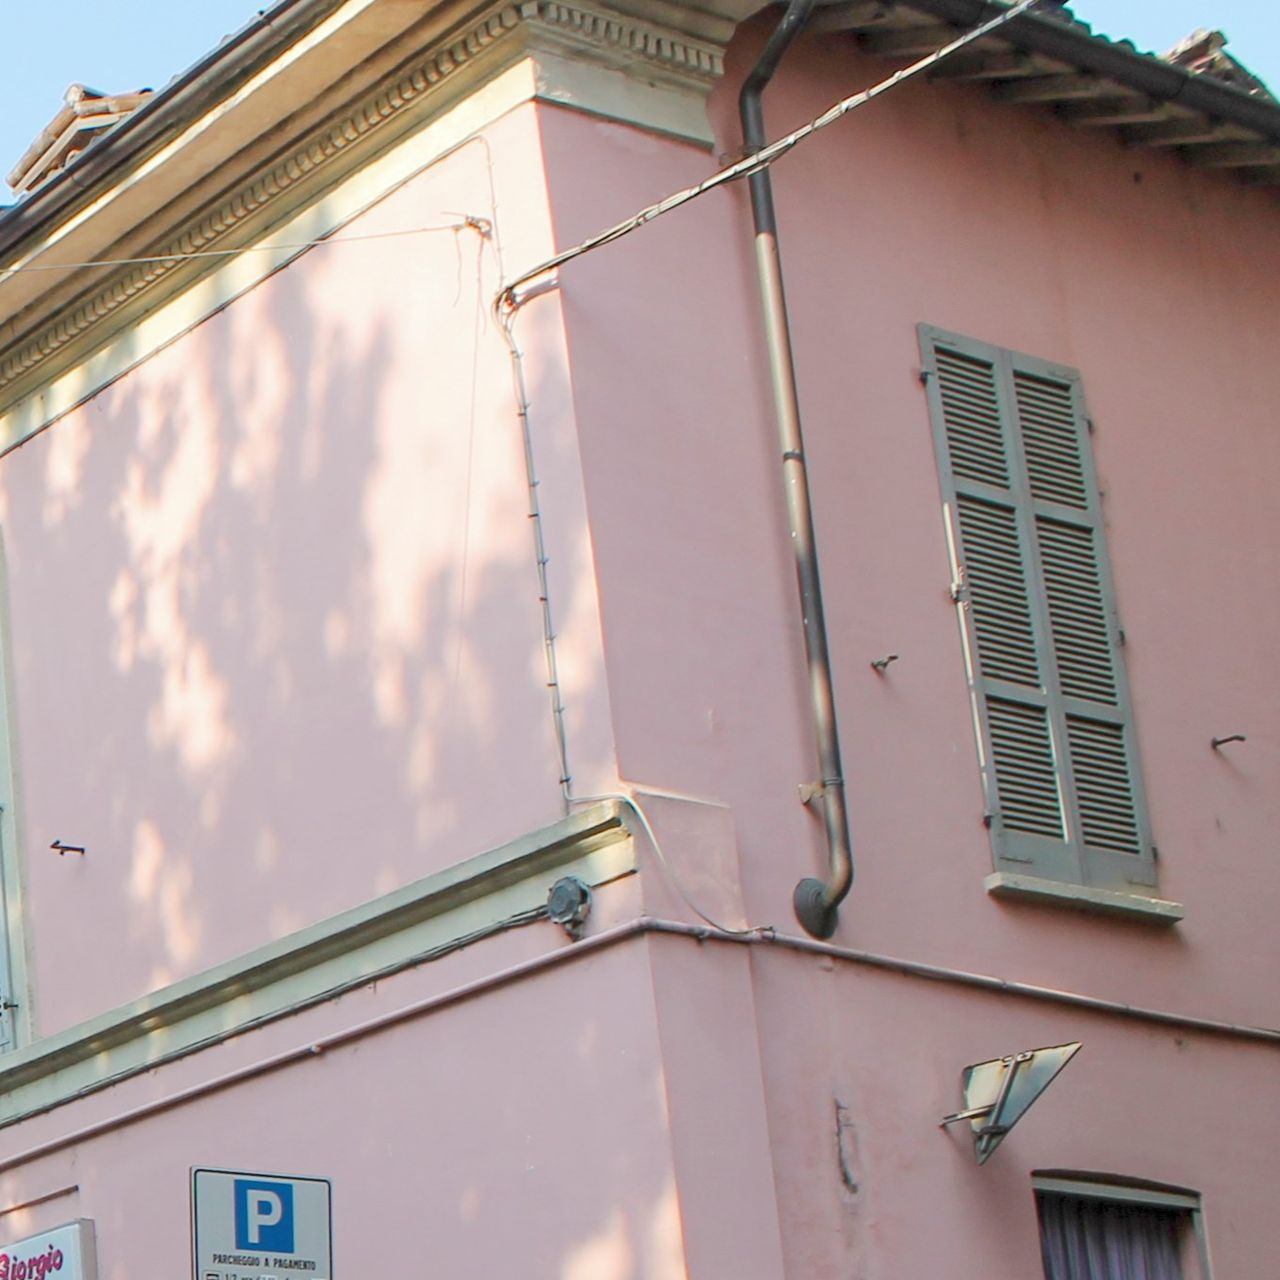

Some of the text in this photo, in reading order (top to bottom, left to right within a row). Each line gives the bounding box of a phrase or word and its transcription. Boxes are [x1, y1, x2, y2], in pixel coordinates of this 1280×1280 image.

[246, 1189, 283, 1244] P
[212, 1254, 317, 1271] PARCHEGGIO A PAGAMENTO
